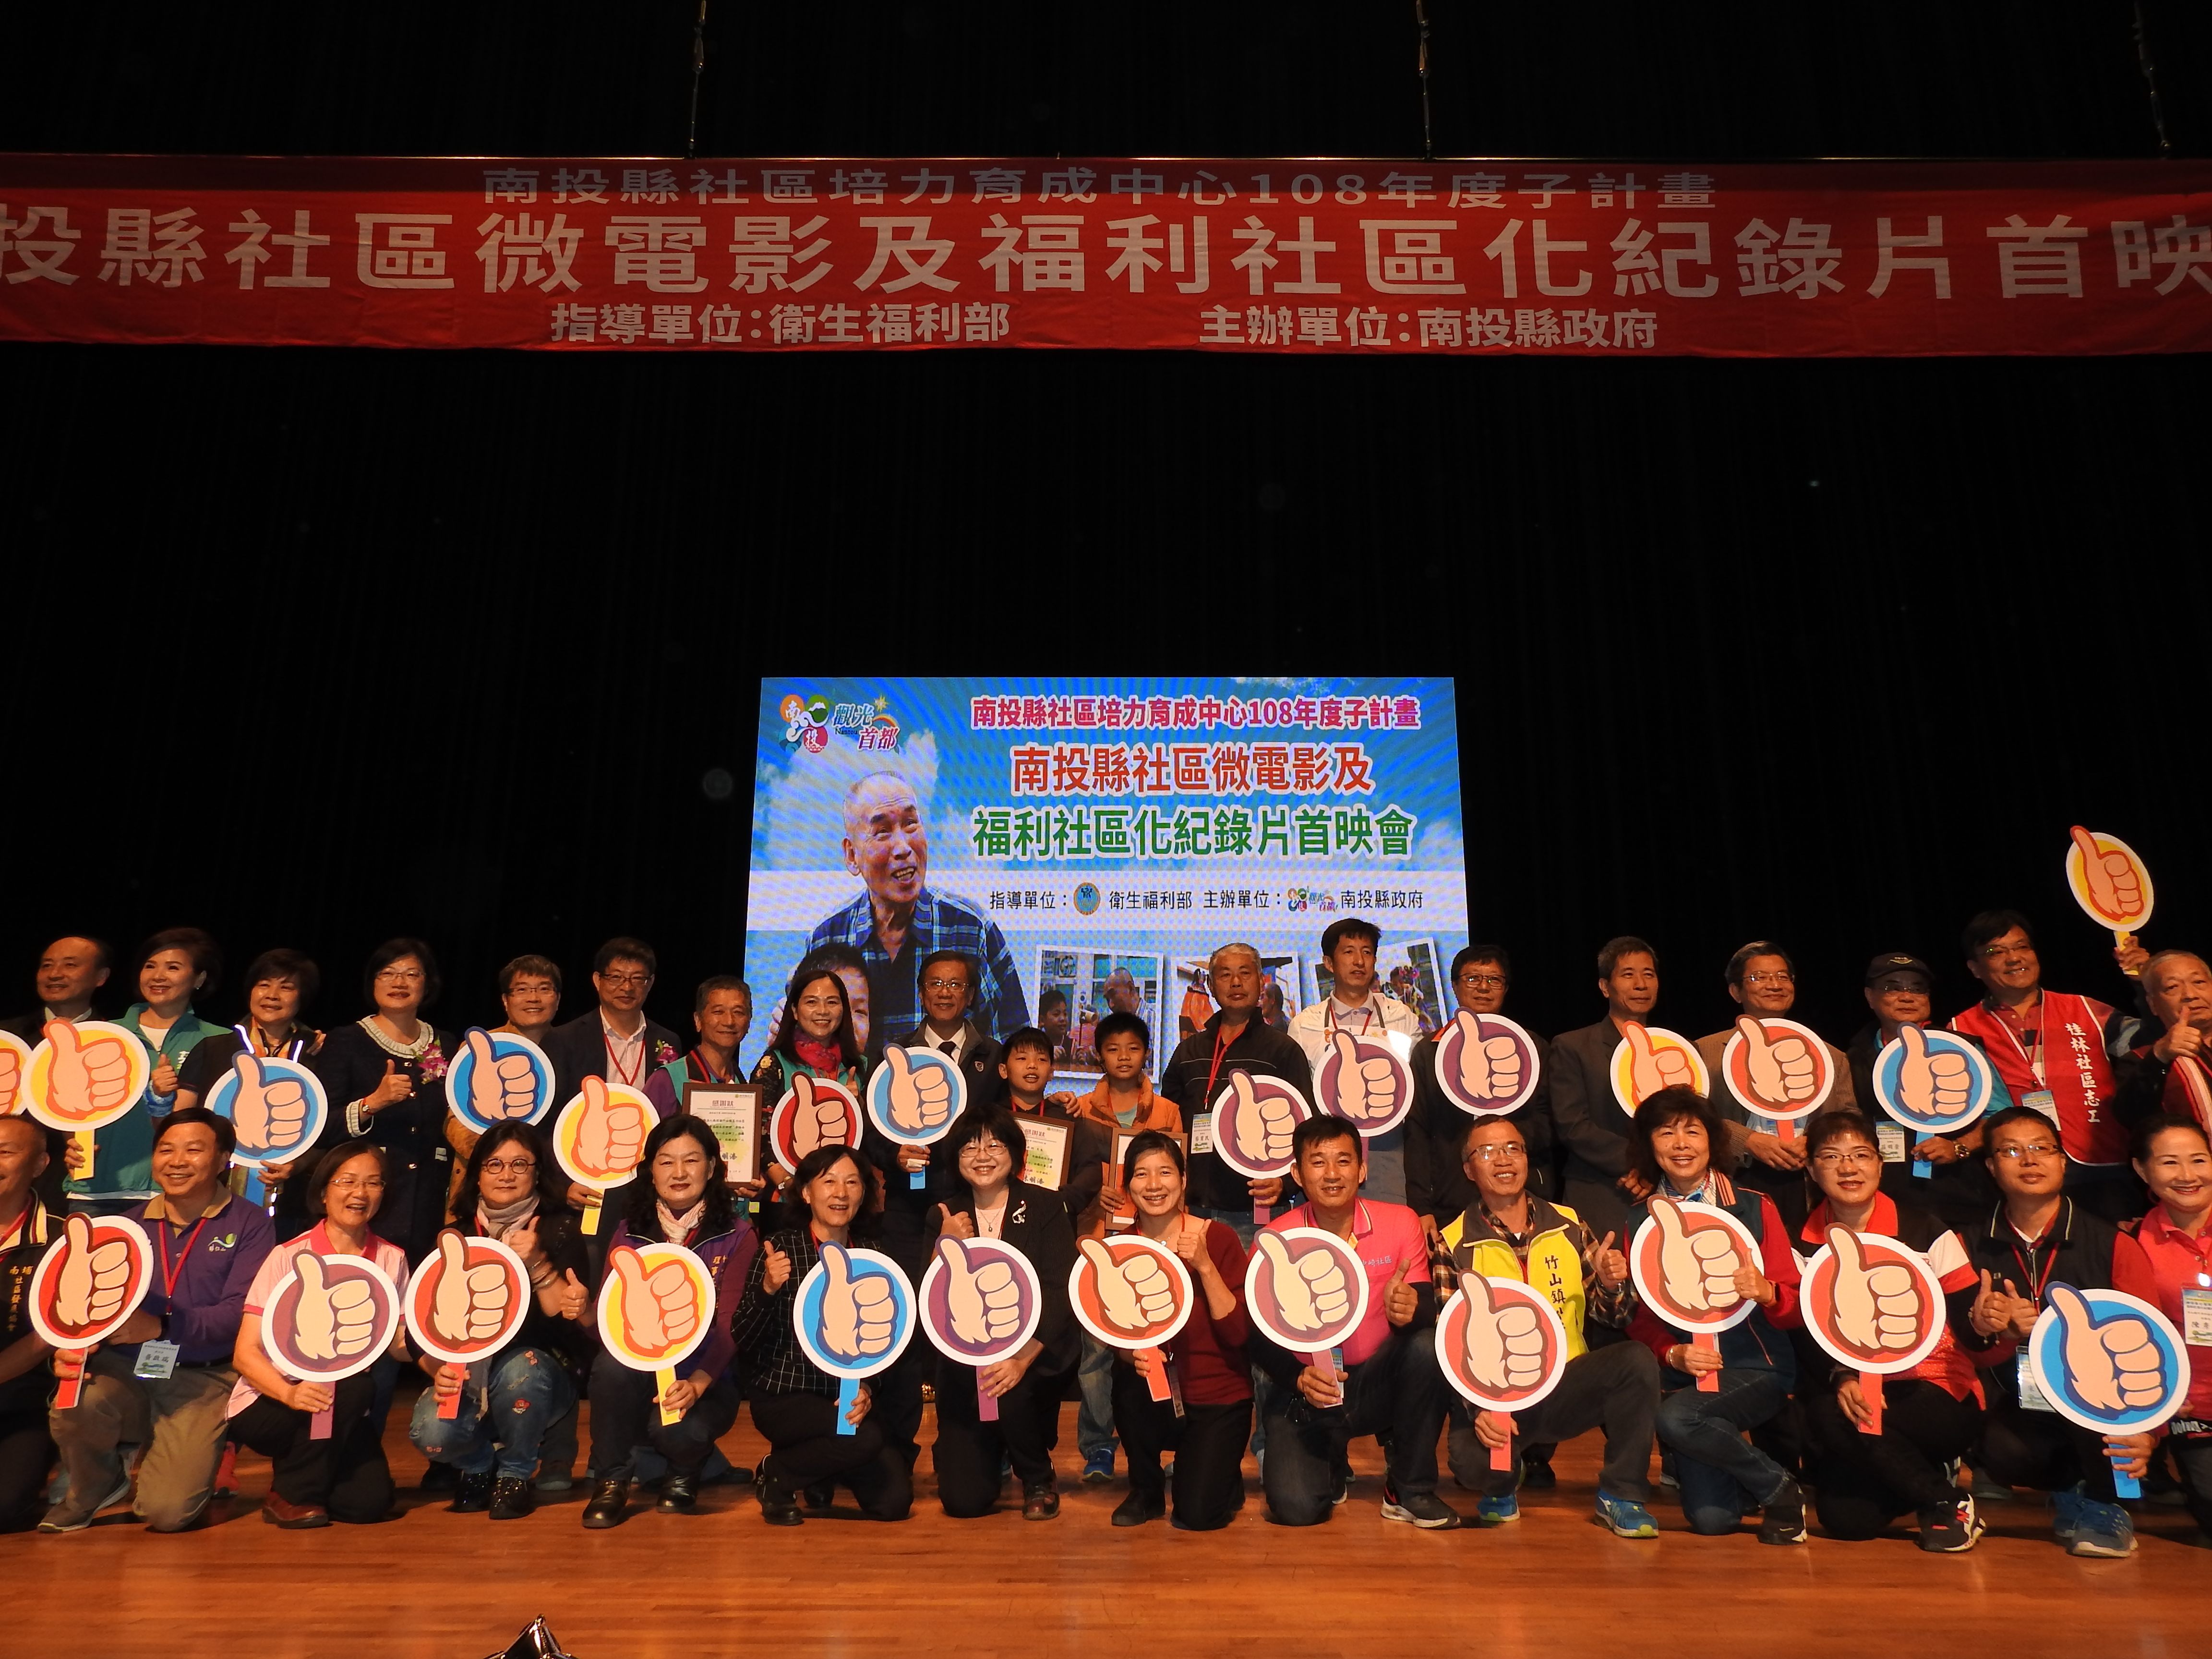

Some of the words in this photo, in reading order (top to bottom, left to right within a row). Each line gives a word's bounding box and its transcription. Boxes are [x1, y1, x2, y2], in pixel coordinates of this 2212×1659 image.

[483, 167, 1716, 209] 南投縣社區培力育成中心108年度子計畫
[0, 204, 2212, 299] 投縣社區微電影及福利社區化紀錄片首映
[551, 302, 1010, 344] 指導單位:衛生福利部
[1199, 304, 1657, 348] 主辦單位:南投縣政府
[973, 698, 1419, 727] 南投縣社區培力育成中心108年度子計畫
[1013, 746, 1372, 793] 南投縣社區微電影及
[973, 808, 1413, 856] 福利社區化紀錄片首映會
[1109, 890, 1192, 910] 衛生福利部
[1340, 890, 1423, 909] 南投縣政府
[2065, 1022, 2101, 1123] 桂林社區志工
